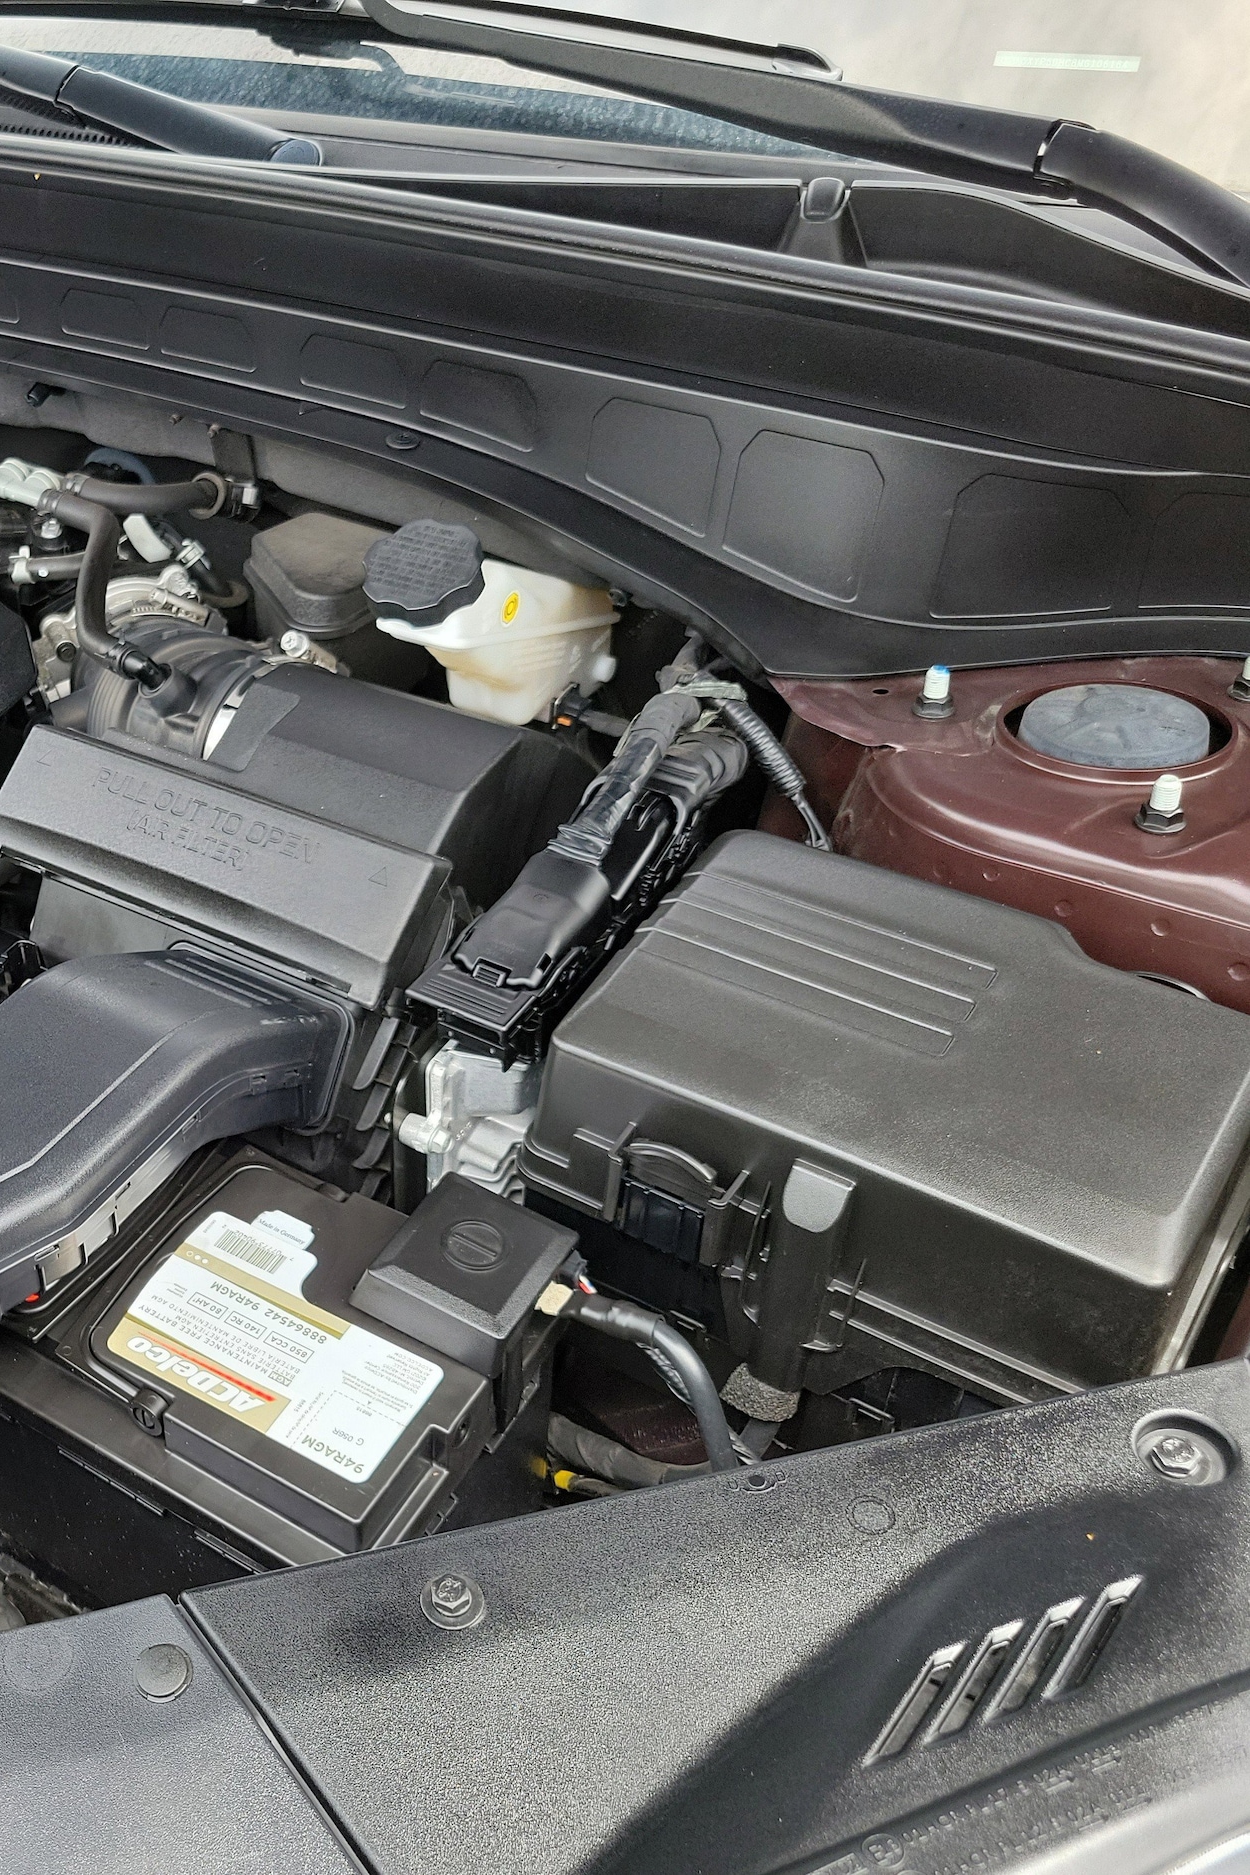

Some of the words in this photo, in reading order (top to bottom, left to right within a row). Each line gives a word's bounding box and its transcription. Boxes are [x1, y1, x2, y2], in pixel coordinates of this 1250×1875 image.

[92, 766, 147, 805] PULL
[153, 789, 208, 822] OUT
[210, 806, 243, 836] TO
[245, 820, 321, 864] OPEN
[150, 1293, 168, 1306] AGM
[209, 1280, 261, 1311] 94RAGM
[137, 1303, 178, 1327] BATTERY
[208, 1303, 222, 1314] 80
[167, 1302, 230, 1337] MANTENIMIENTO
[174, 1313, 192, 1326] AGM
[228, 1314, 244, 1325] RC
[242, 1321, 261, 1334] 140
[262, 1307, 328, 1345] 88864542
[178, 1324, 202, 1340] FREE
[191, 1323, 235, 1348] ENTRETIEN
[229, 1334, 242, 1344] DE
[241, 1340, 266, 1356] LIBRE
[268, 1334, 289, 1348] CCA
[202, 1336, 268, 1374] MAINTENANCE
[235, 1345, 257, 1359] SANS
[288, 1344, 308, 1358] 850
[125, 1337, 266, 1413] ACDelco
[256, 1356, 296, 1380] BATTERIE
[300, 1433, 366, 1475] 94RAGM
